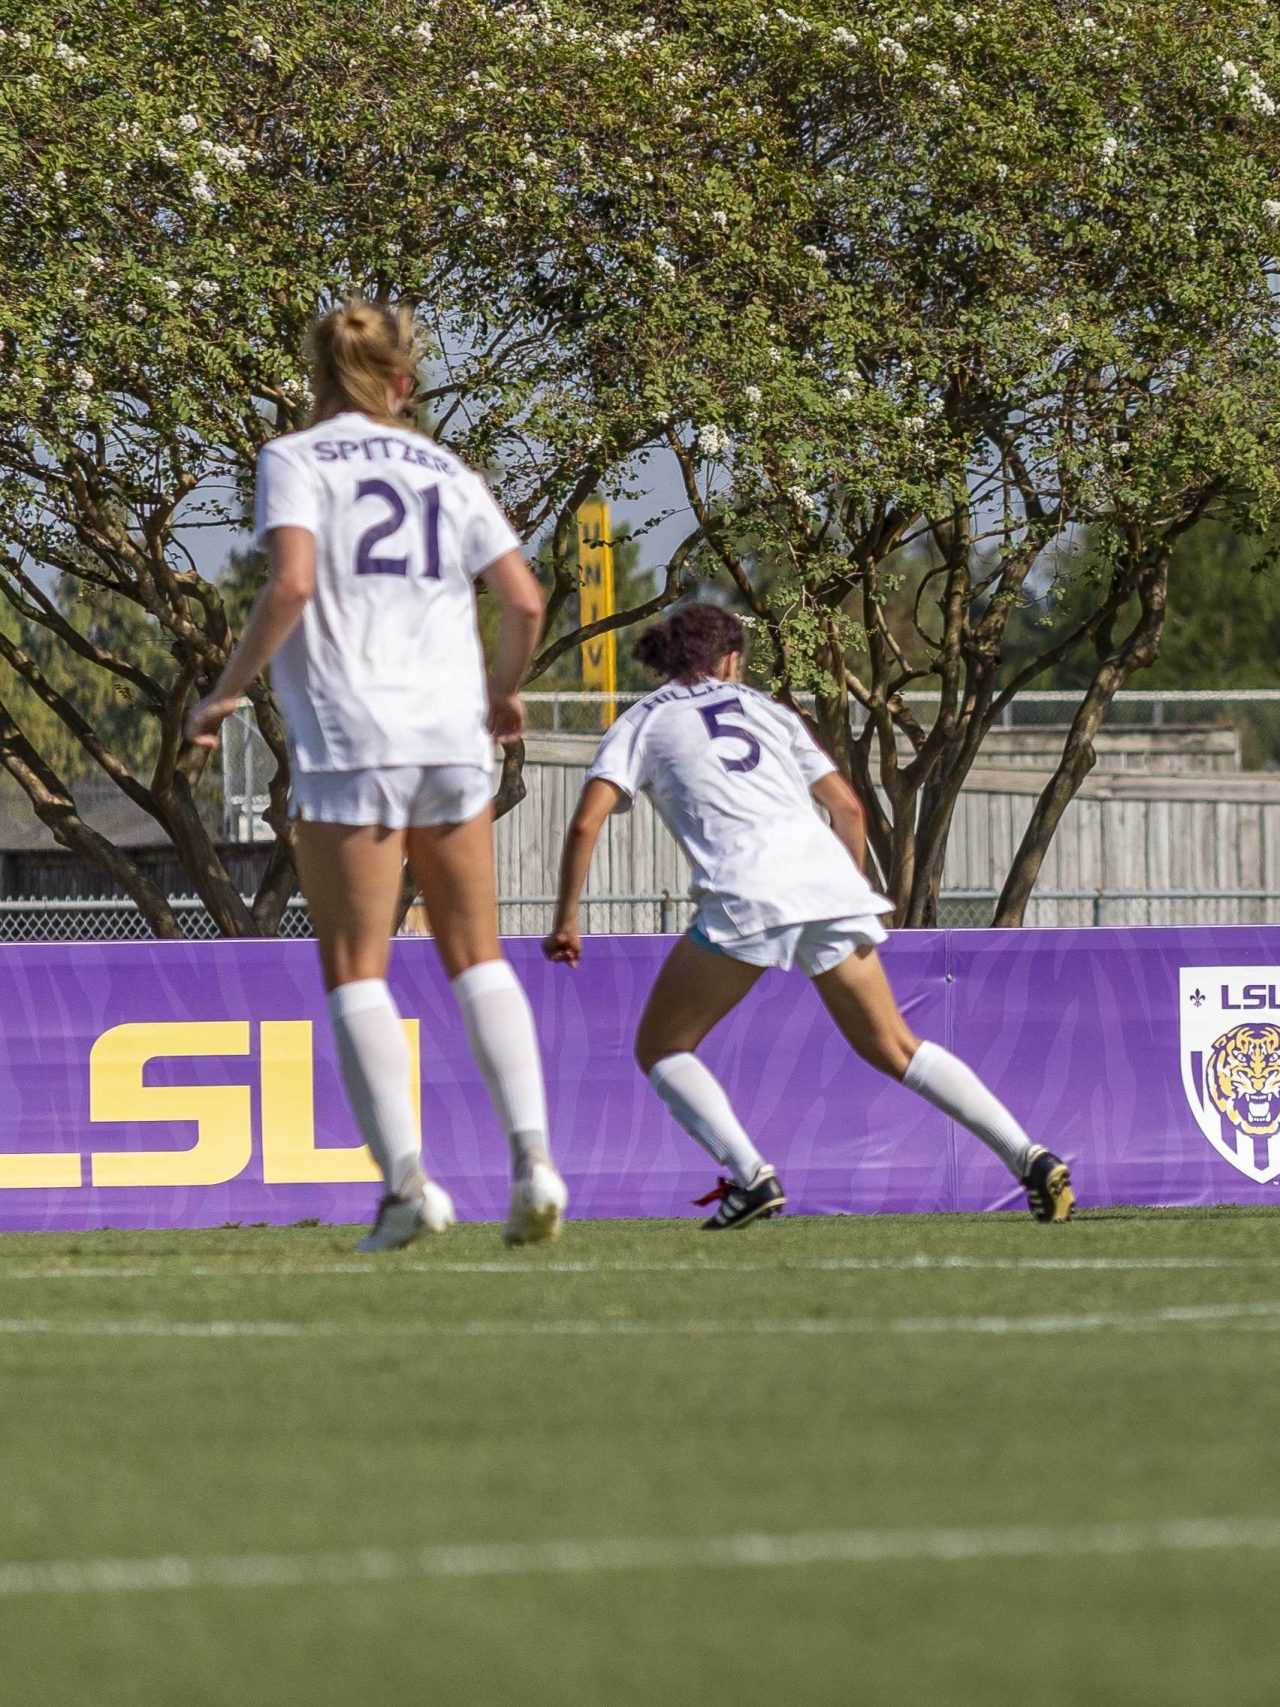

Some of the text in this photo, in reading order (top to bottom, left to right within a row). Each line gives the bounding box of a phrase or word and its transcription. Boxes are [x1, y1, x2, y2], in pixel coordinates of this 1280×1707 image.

[355, 478, 441, 579] 21
[696, 697, 761, 773] 5
[0, 1018, 422, 1189] SU
